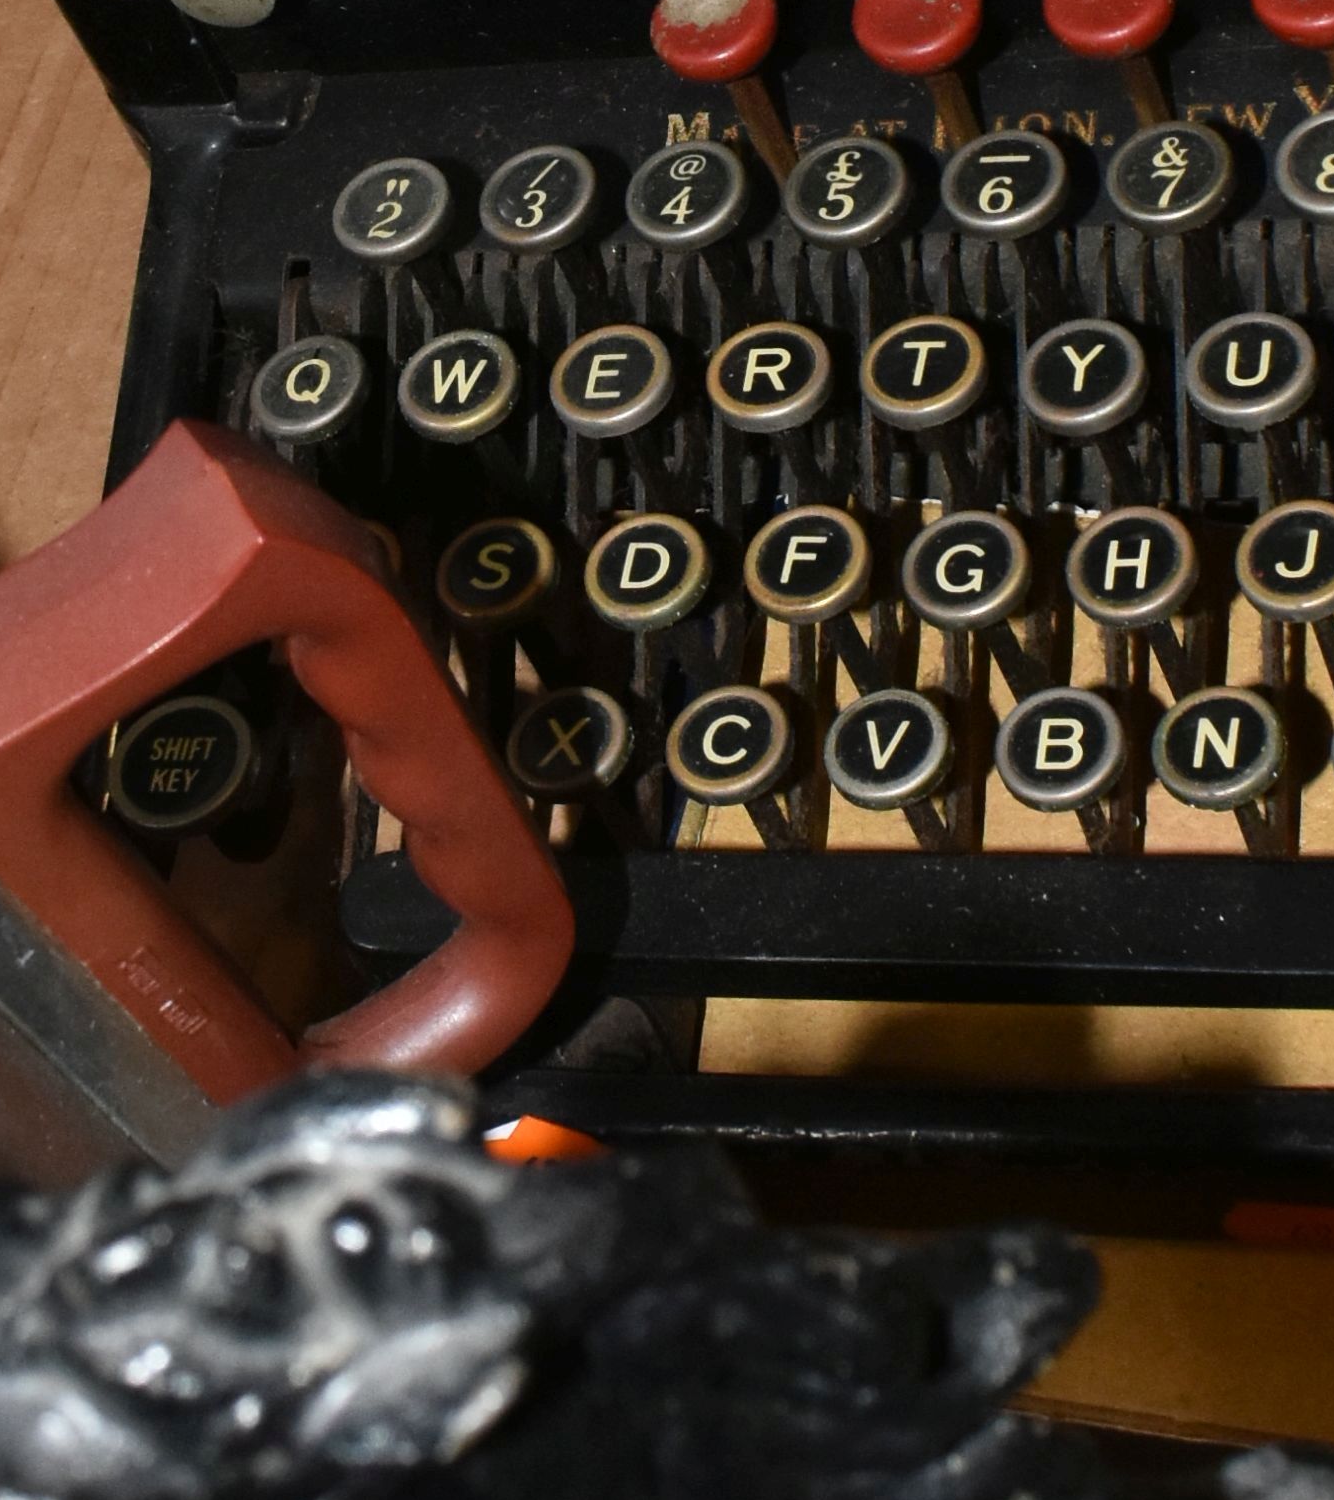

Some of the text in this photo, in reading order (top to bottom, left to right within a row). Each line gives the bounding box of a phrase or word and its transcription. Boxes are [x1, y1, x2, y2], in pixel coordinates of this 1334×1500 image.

[514, 189, 547, 228] 3
[660, 186, 694, 225] 4
[818, 182, 856, 221] 5
[978, 176, 1014, 214] 6
[1151, 168, 1186, 209] 7
[367, 201, 403, 239] 2
[285, 358, 331, 404] Q
[433, 359, 488, 404] W
[584, 353, 628, 399] E
[742, 347, 792, 392] R
[903, 340, 947, 387] T
[1062, 344, 1105, 392] Y
[1226, 340, 1272, 387] U
[470, 543, 515, 590] S
[619, 542, 671, 589] D
[780, 535, 828, 584] F
[935, 543, 985, 593] G
[1104, 538, 1151, 591] H
[1275, 529, 1319, 579] J
[149, 736, 217, 761] SHIFT
[538, 716, 592, 767] X
[702, 714, 752, 765] C
[866, 720, 910, 770] V
[1035, 718, 1084, 770] B
[1192, 717, 1240, 769] N
[149, 769, 201, 792] KEY
